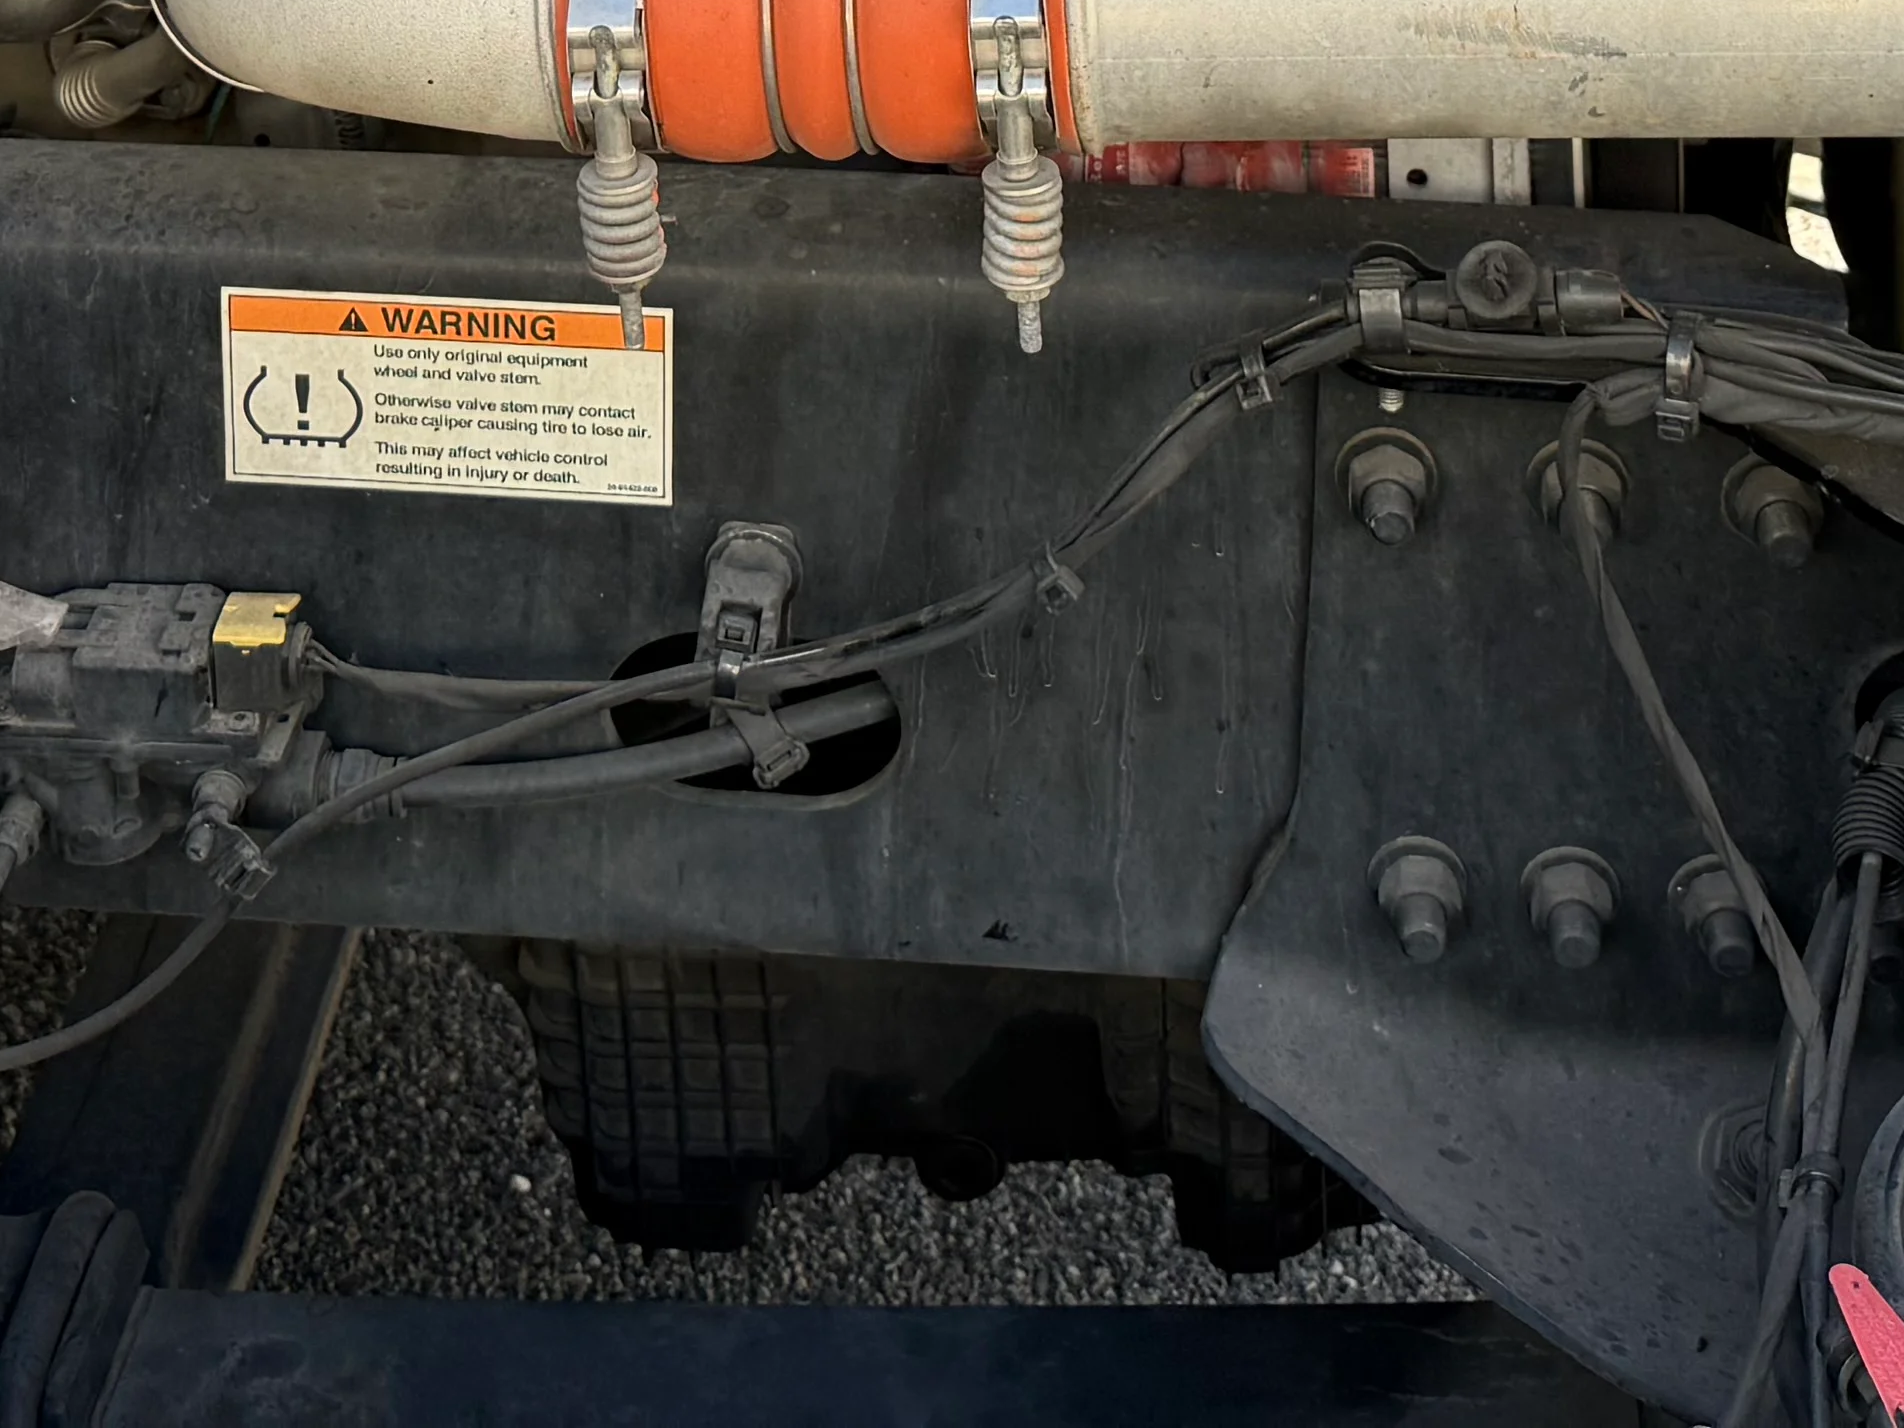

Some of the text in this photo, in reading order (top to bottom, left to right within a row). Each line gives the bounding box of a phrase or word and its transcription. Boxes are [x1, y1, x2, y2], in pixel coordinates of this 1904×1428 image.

[381, 307, 556, 342] WARNING
[374, 344, 588, 370] Use only original equipment
[374, 365, 541, 386] wheel and valve stem.
[375, 393, 636, 420] Otherwise valve stem may contact
[374, 412, 652, 439] brake caliper causing tire to lose air.
[375, 441, 608, 467] This may affect vehicle control
[375, 462, 581, 485] resulting in injury or death.
